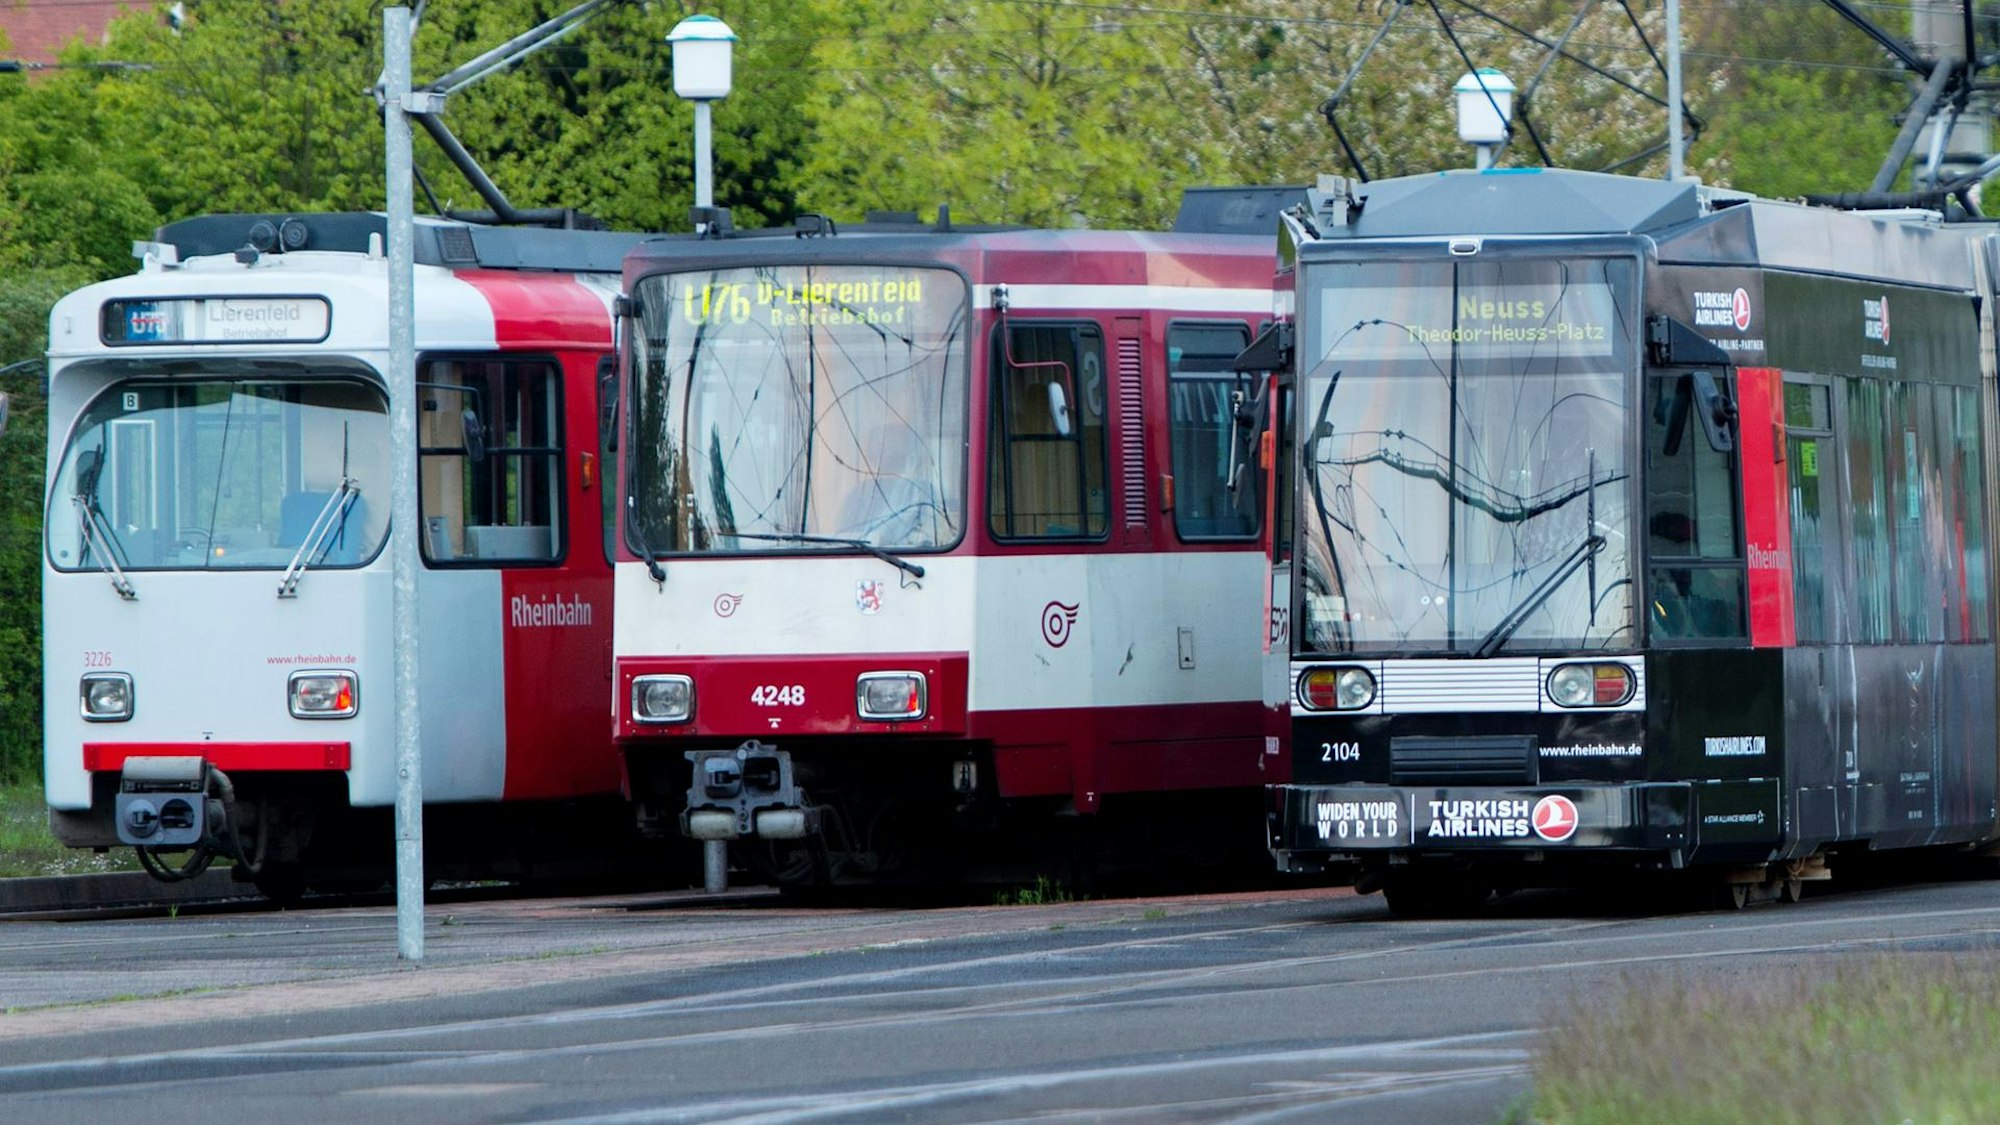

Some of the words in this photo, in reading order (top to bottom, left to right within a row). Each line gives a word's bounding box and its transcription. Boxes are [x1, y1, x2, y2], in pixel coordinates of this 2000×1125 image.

[685, 283, 750, 325] U76
[1459, 296, 1546, 319] Neuss
[1694, 292, 1732, 308] TURKISH
[209, 303, 300, 322] Lierenfeld
[771, 307, 905, 326] Betriebshof
[1695, 309, 1733, 326] AIRLINES
[223, 327, 288, 338] Betriebshof
[1407, 323, 1605, 343] Theodor-Heuss-Platz
[127, 394, 135, 408] B
[1748, 543, 1786, 569] Rhein
[511, 593, 592, 627] Rheinbahn
[84, 652, 112, 667] 3226
[267, 654, 357, 665] www.rheinbahn.de
[751, 685, 806, 706] 4248
[1321, 742, 1360, 761] 2104
[1539, 744, 1643, 757] www.rheinbahn.de
[1704, 736, 1766, 756] TURKISHAIRLINES.COM
[1317, 802, 1359, 820] WIDEN
[1362, 802, 1398, 820] YOUR
[1429, 800, 1529, 820] TURKISH
[1428, 820, 1529, 837] AIRLINES
